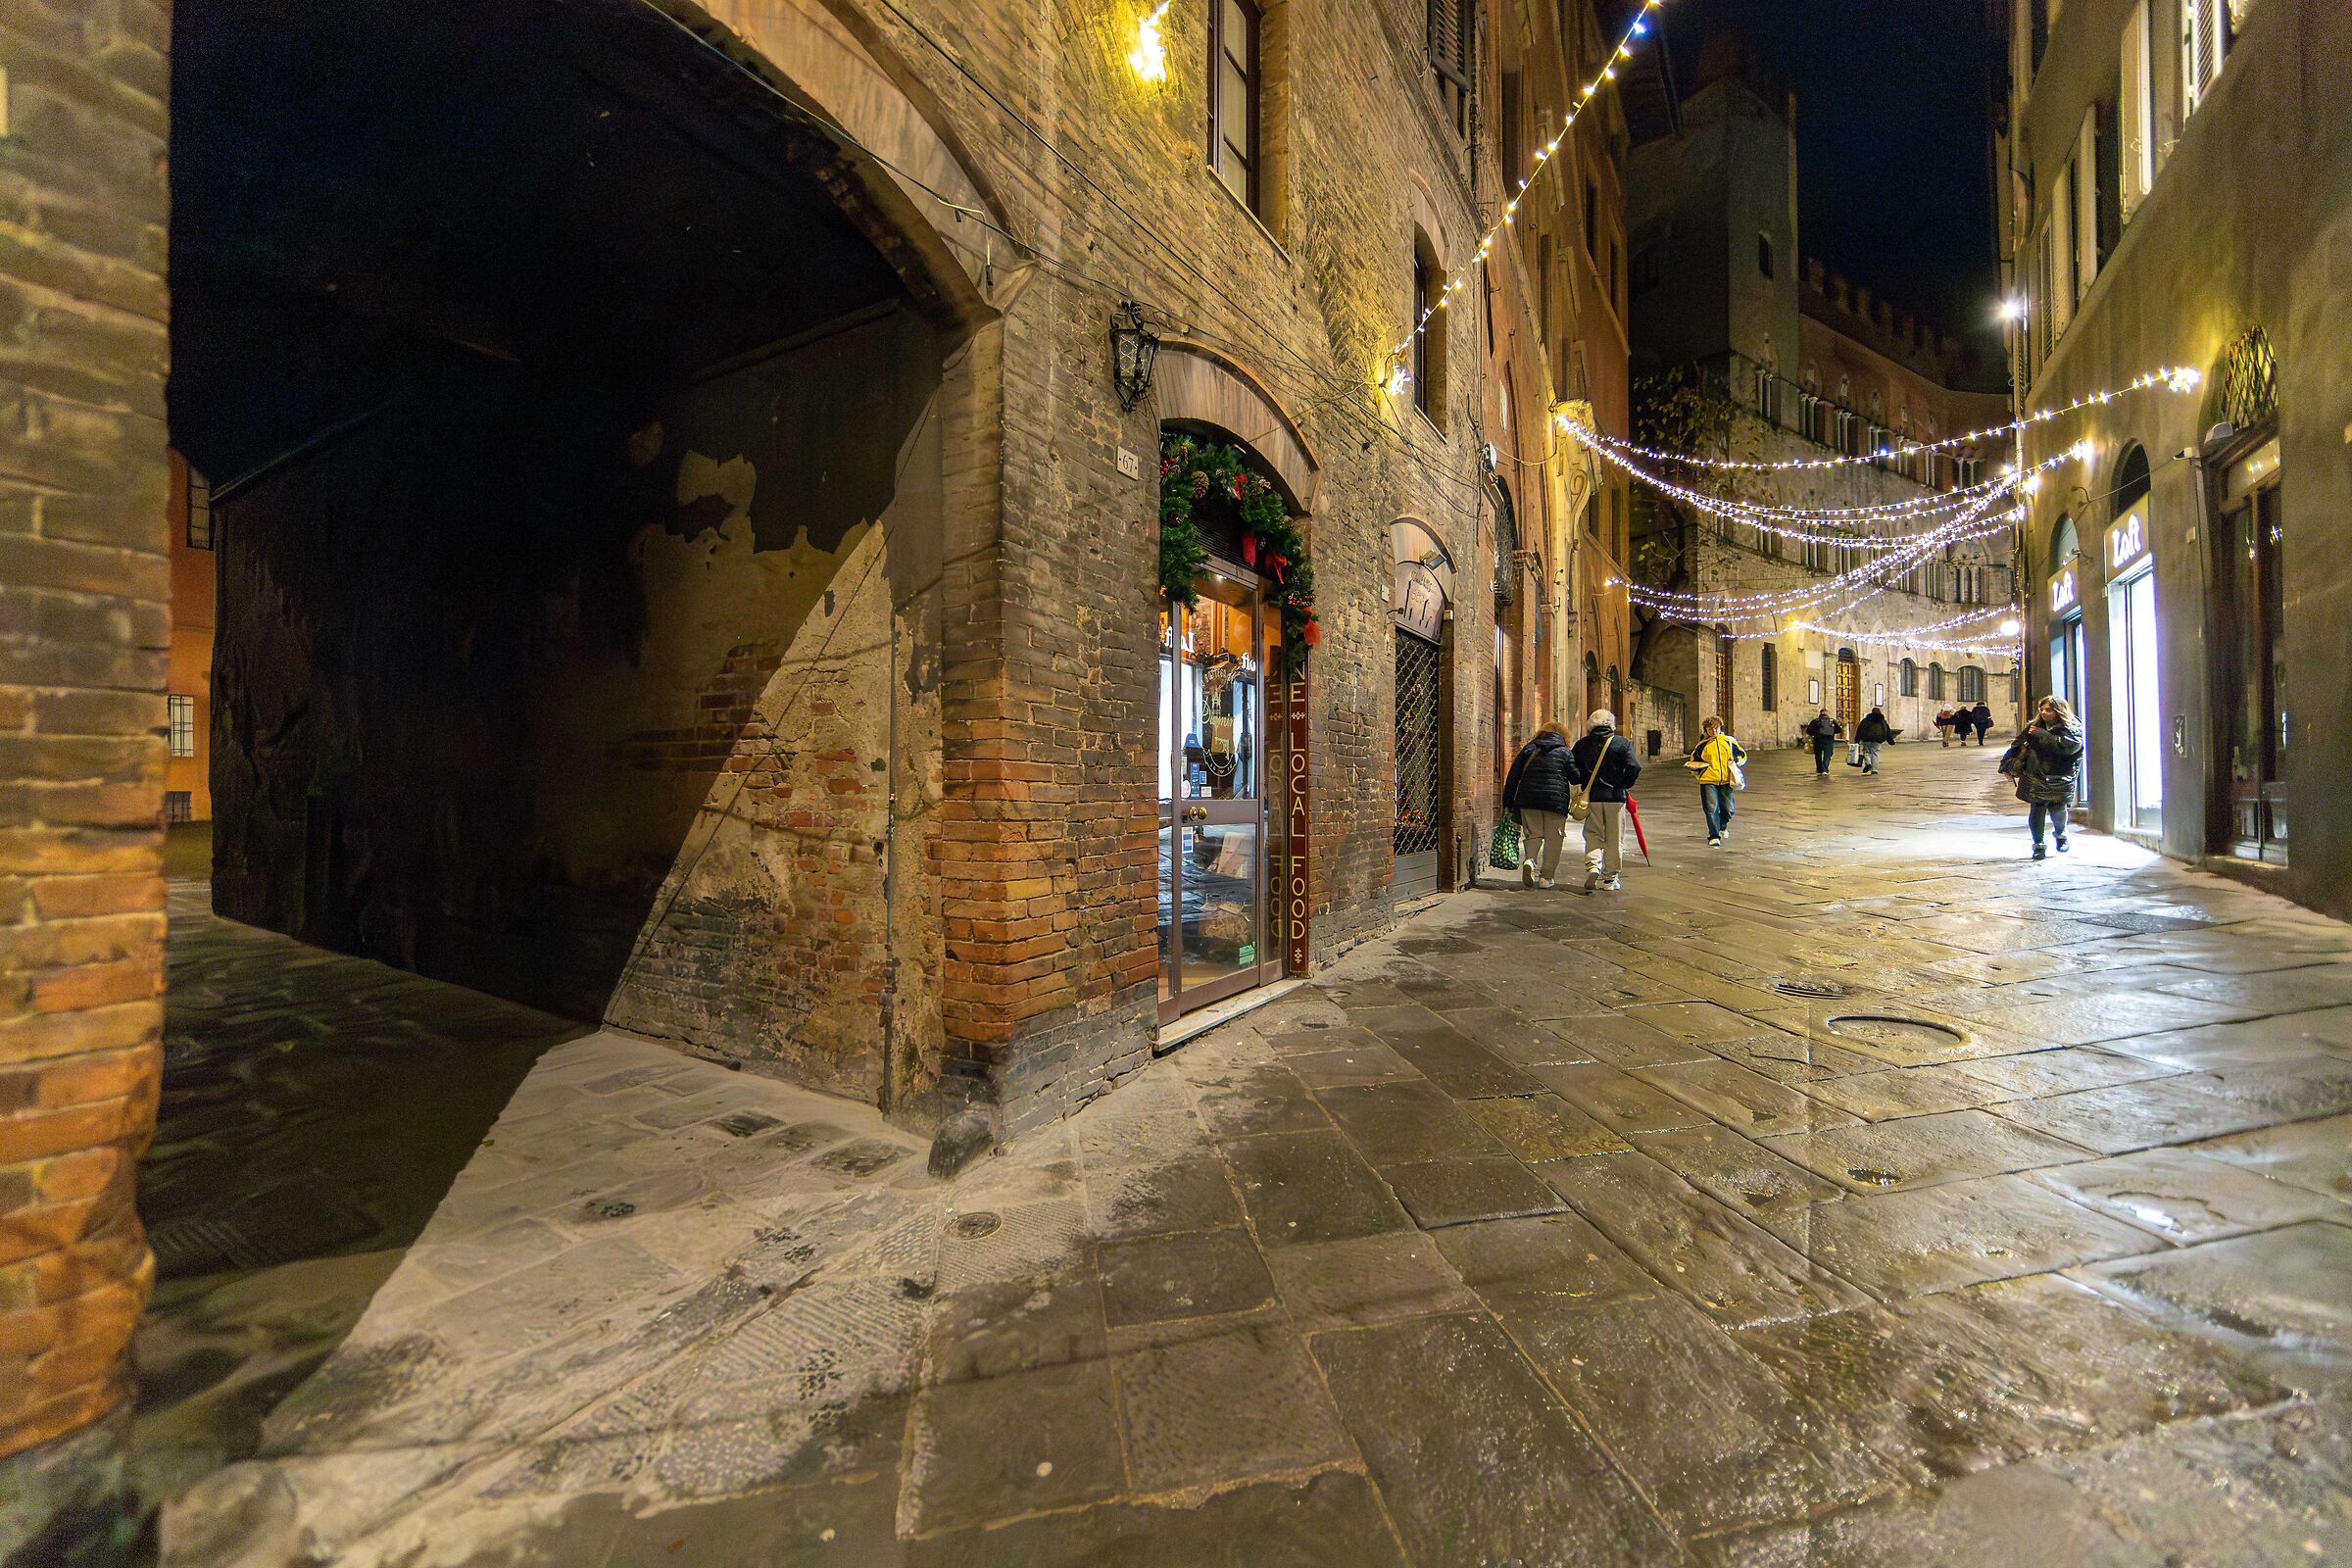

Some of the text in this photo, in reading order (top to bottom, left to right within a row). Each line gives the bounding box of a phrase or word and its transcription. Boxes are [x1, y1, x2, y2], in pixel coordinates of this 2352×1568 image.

[1123, 455, 1134, 472] 67
[2112, 514, 2141, 568] Loft
[2052, 570, 2074, 612] Loft
[1291, 732, 1305, 837] LOCAL
[1291, 856, 1305, 940] FOOD
